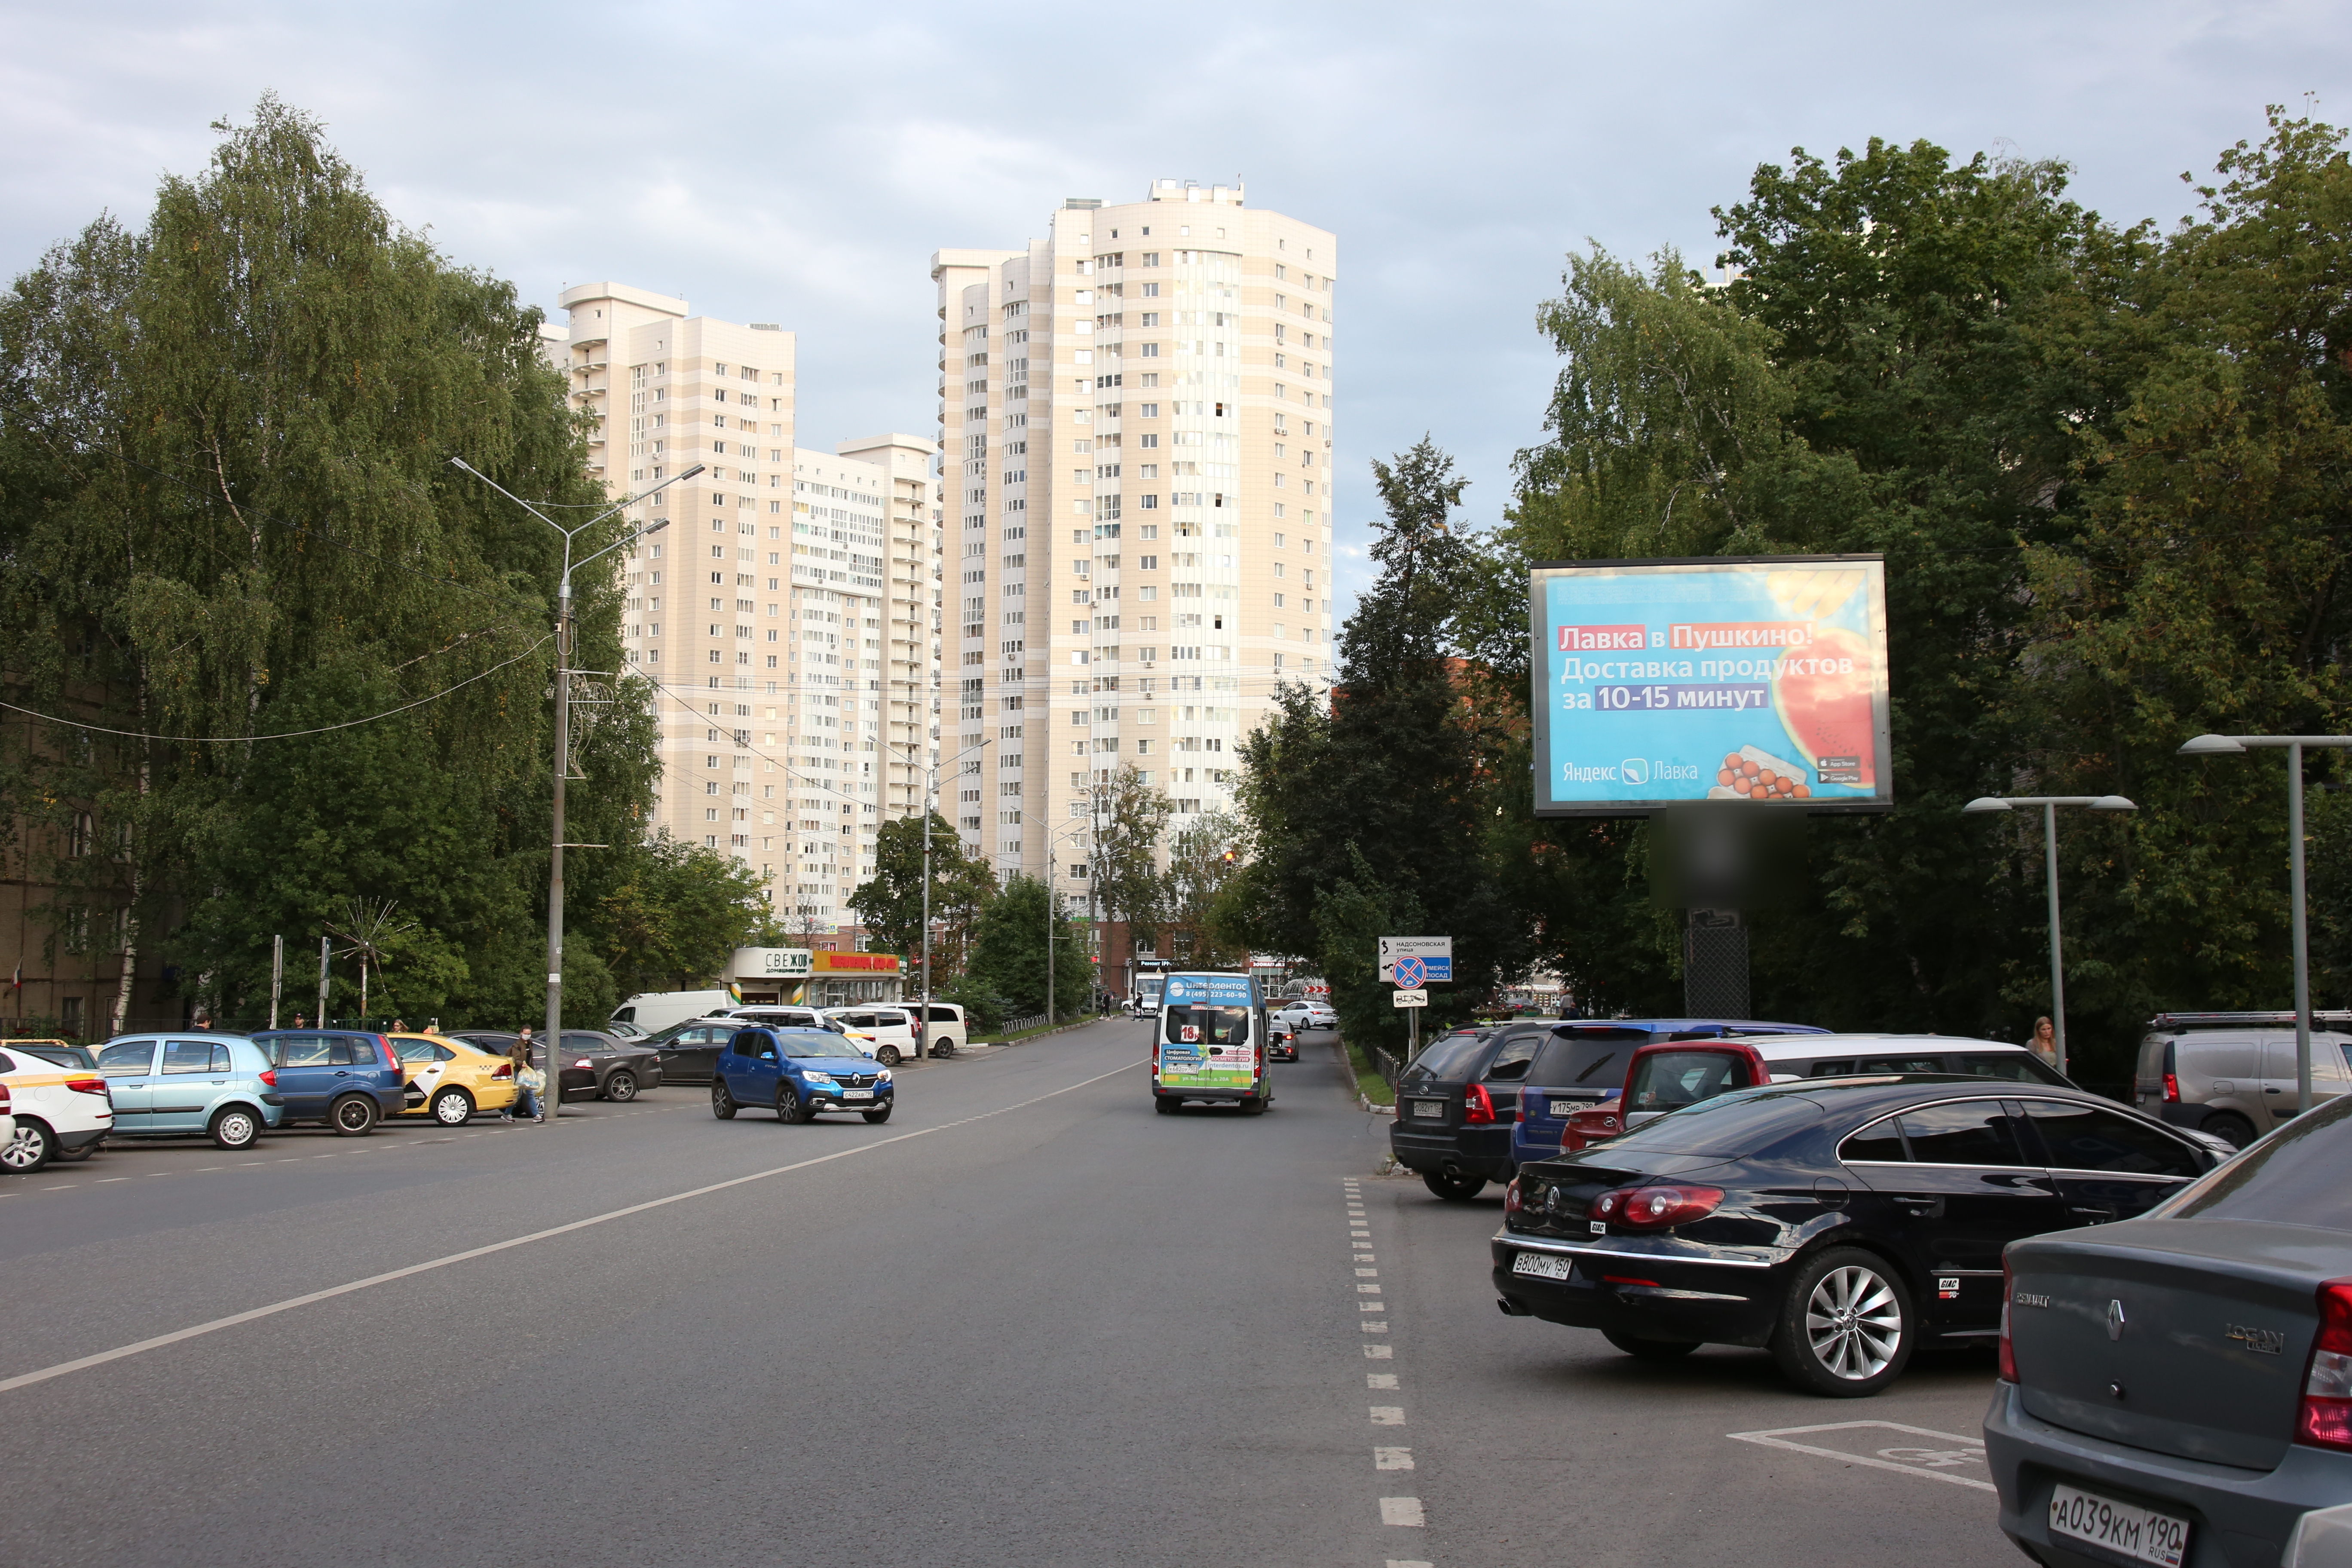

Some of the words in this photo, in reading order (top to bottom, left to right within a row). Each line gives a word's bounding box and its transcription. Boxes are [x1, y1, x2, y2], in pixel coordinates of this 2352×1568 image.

[1561, 628, 1643, 649] Лавка
[1651, 631, 1665, 647] в
[1674, 623, 1813, 652] Пушкино!
[1561, 658, 1693, 684] Доставка
[1701, 658, 1853, 681] продуктов
[1563, 692, 1591, 709] за
[1599, 686, 1669, 709] 10-15
[1677, 690, 1764, 711] минут
[1563, 762, 1616, 782] Яндекс
[1654, 761, 1697, 779] Лавка
[1592, 1223, 1604, 1232] GIAC
[1516, 1255, 1552, 1274] В800МУ
[1555, 1258, 1569, 1272] 150
[2016, 1292, 2049, 1308] RENAULT
[2226, 1323, 2284, 1345] LOGAN
[2056, 1496, 2141, 1550] А039КМ
[2147, 1516, 2180, 1550] 190
[2148, 1546, 2165, 1560] RUS
